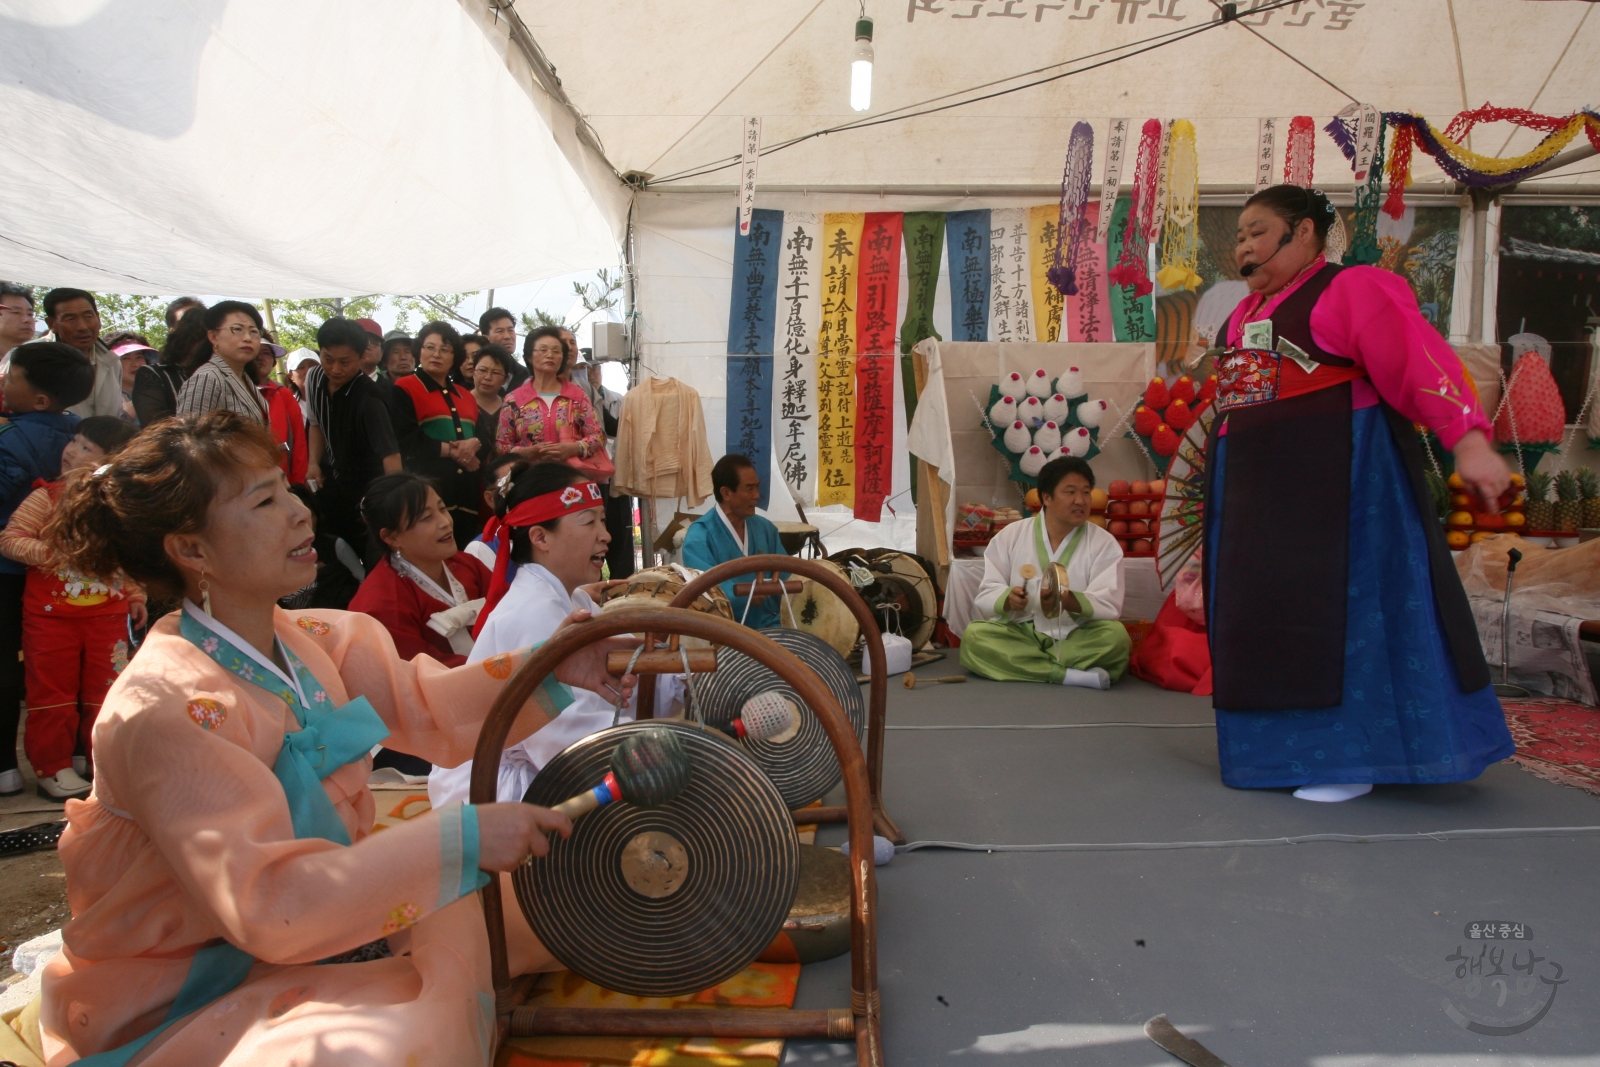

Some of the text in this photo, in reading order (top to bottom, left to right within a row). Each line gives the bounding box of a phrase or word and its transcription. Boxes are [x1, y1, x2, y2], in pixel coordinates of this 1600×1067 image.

[1258, 120, 1274, 191] 奉請第四五
